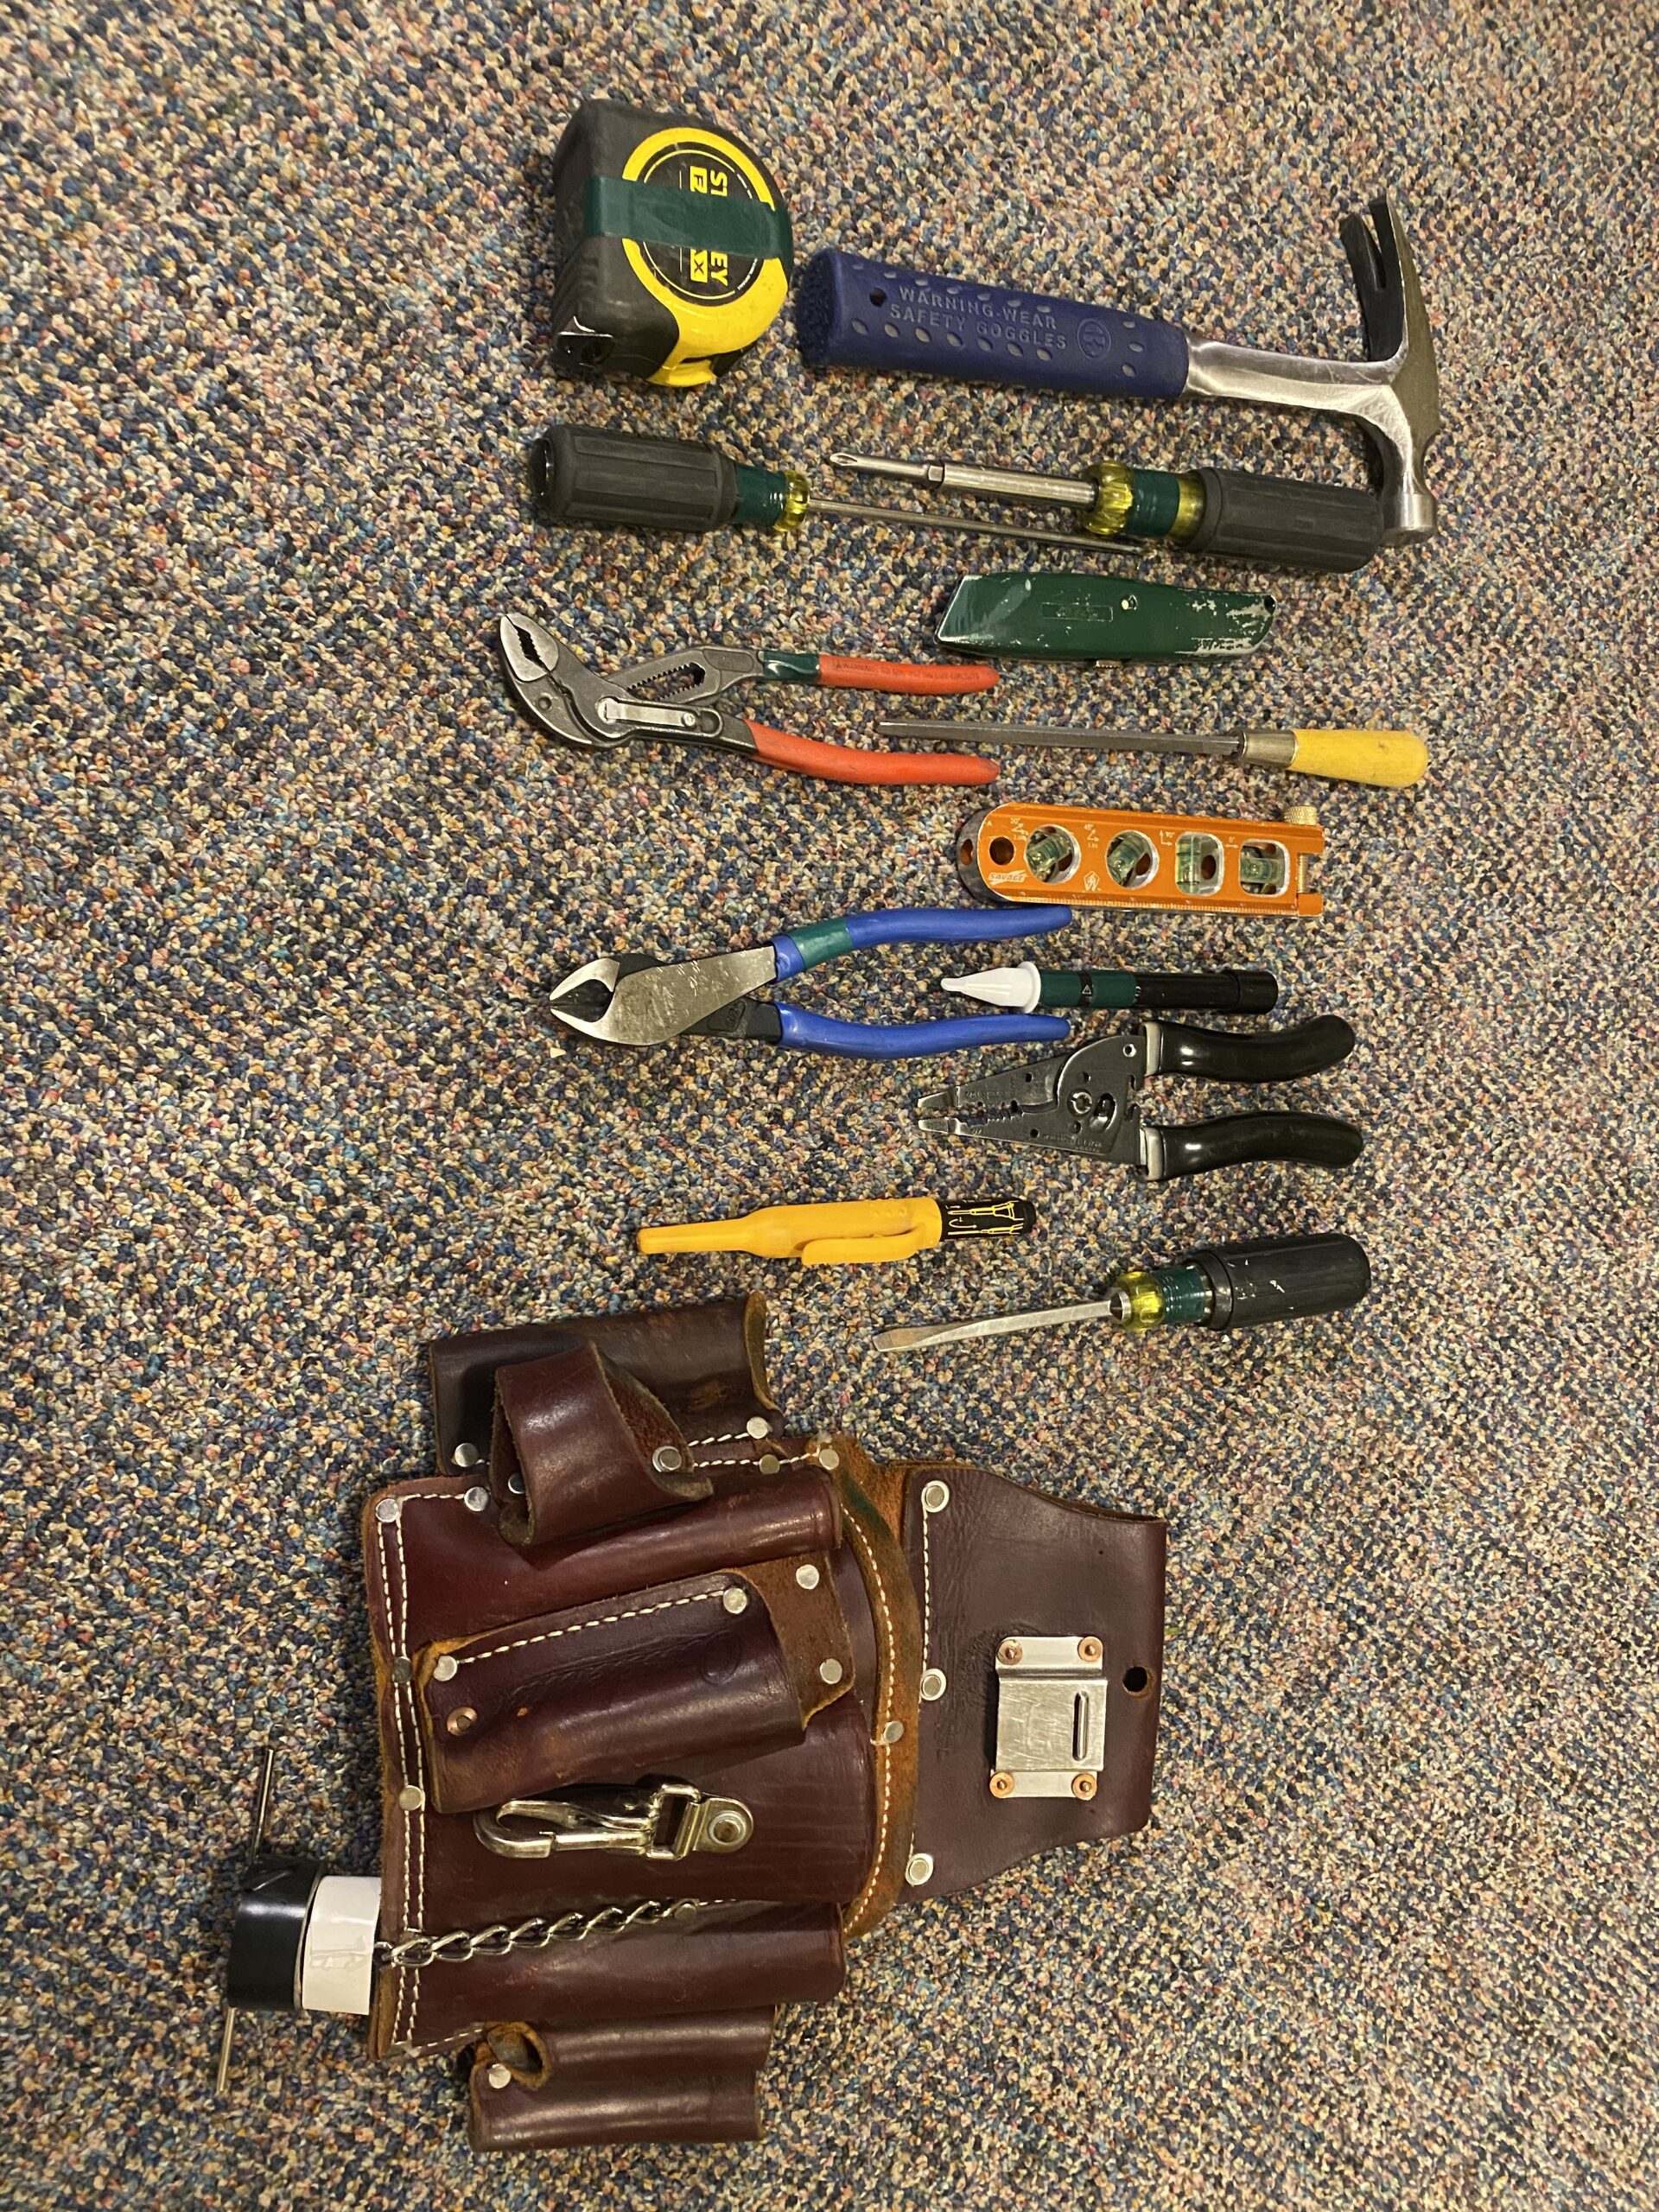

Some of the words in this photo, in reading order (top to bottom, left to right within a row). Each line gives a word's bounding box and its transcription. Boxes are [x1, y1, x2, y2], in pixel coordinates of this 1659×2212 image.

[709, 170, 728, 286] STEY
[890, 304, 967, 332] SAFETY
[976, 321, 1067, 349] GOGGLES
